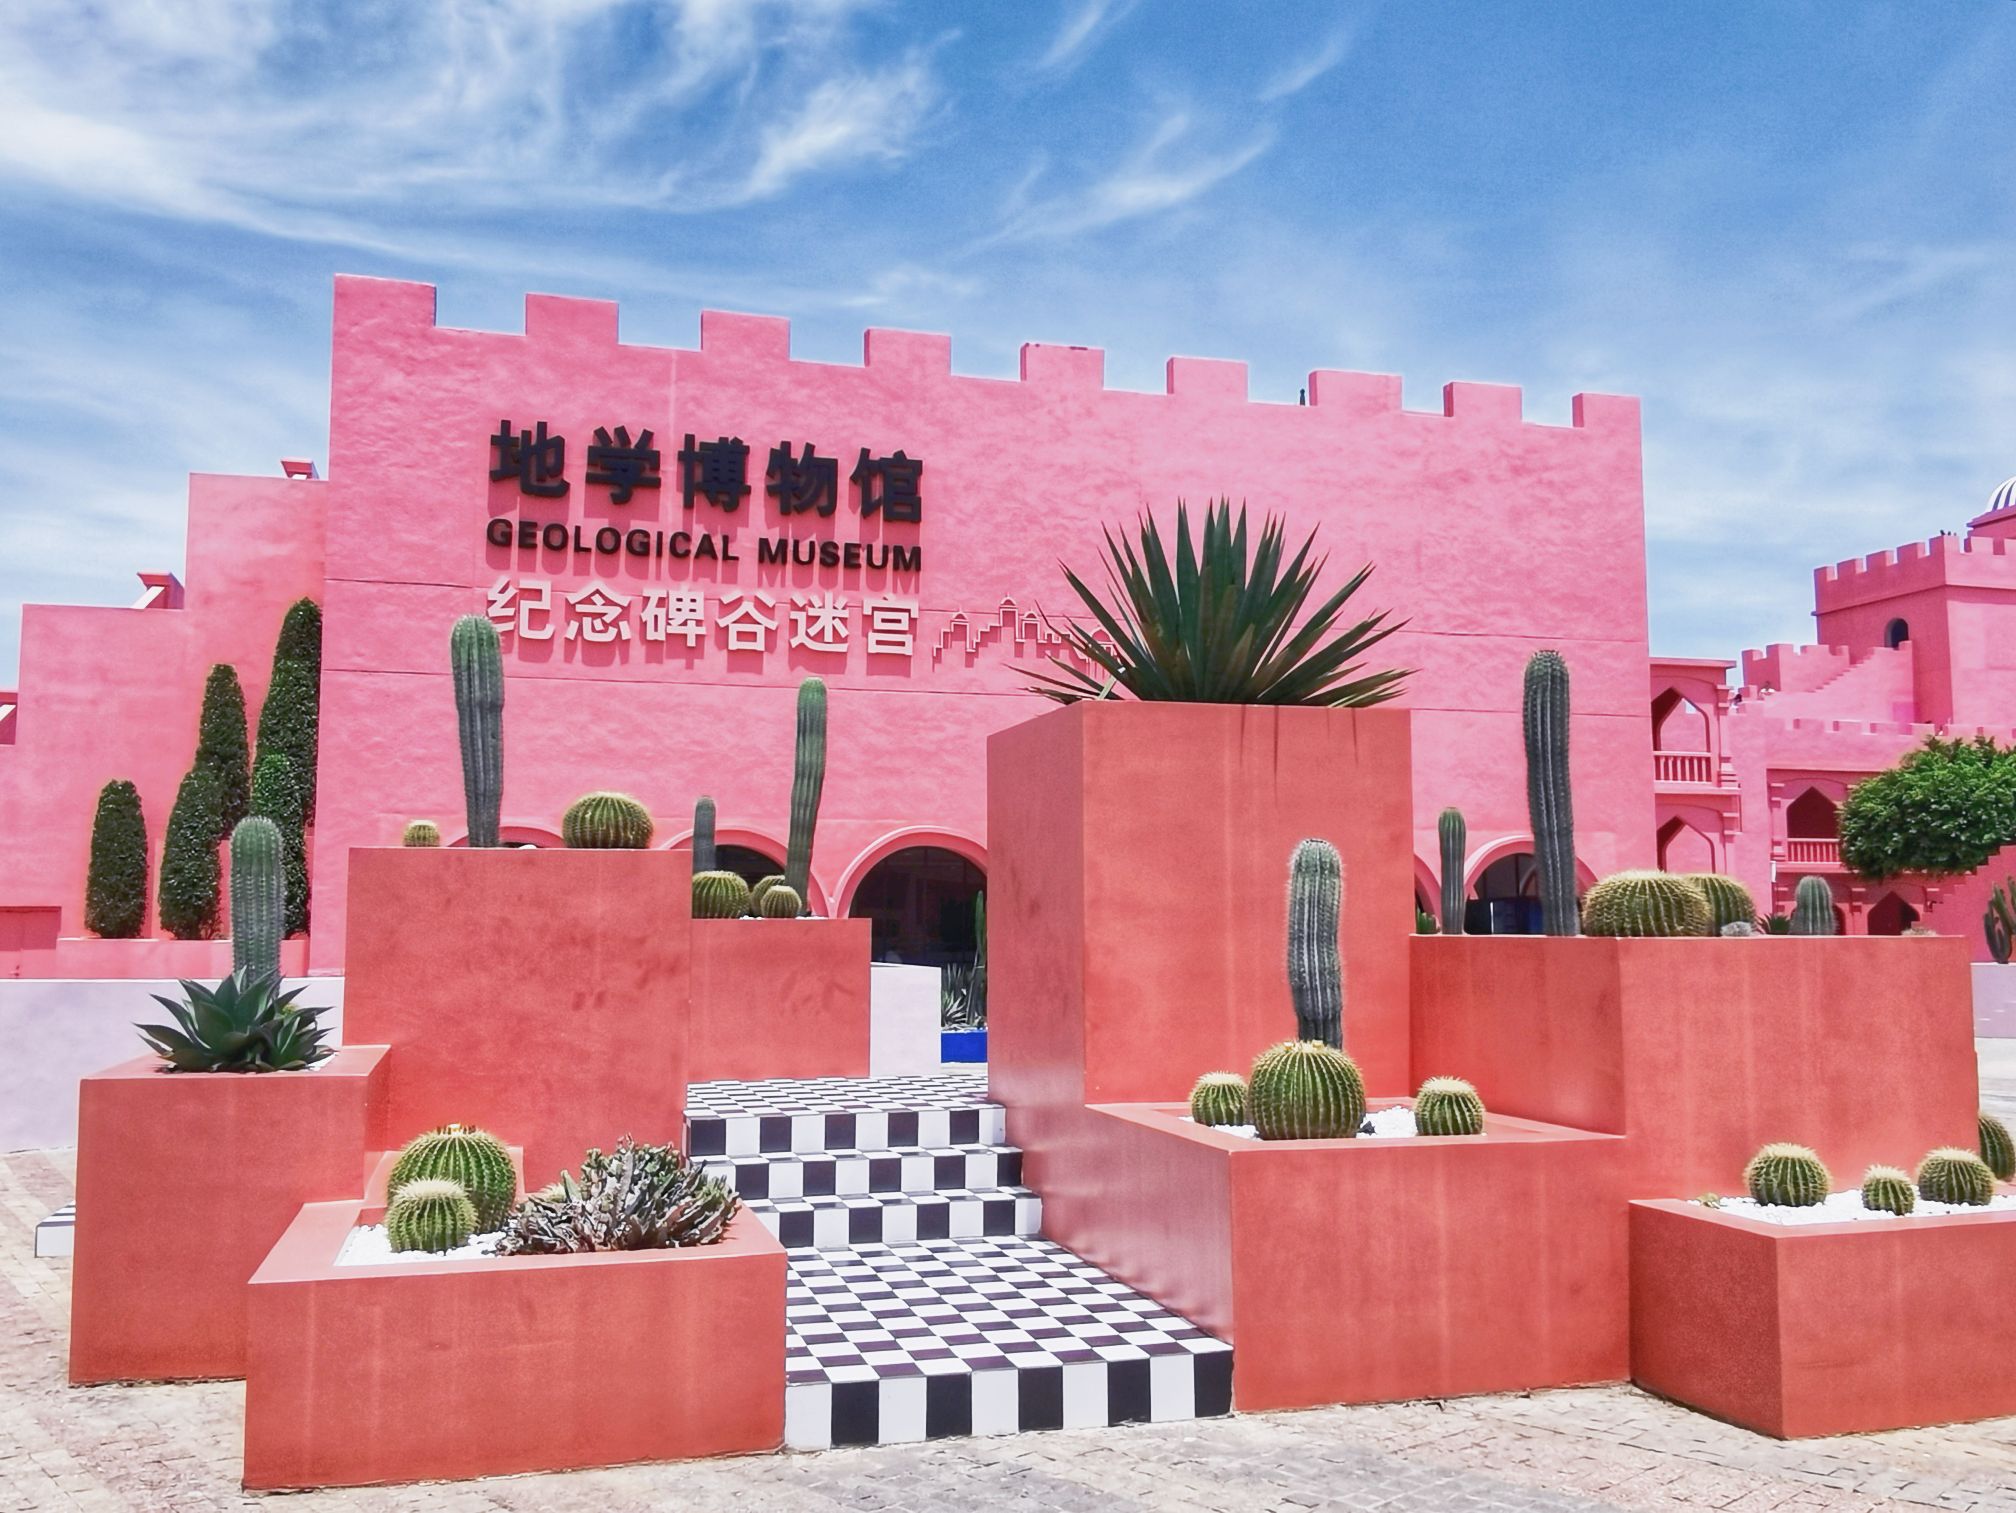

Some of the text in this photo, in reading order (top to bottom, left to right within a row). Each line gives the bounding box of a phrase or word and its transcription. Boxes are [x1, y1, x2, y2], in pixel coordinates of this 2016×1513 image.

[490, 419, 923, 522] 地学博物馆
[486, 518, 922, 572] GEOLOGICAL MUSEUM
[487, 579, 919, 656] 纪念碑谷迷宫
